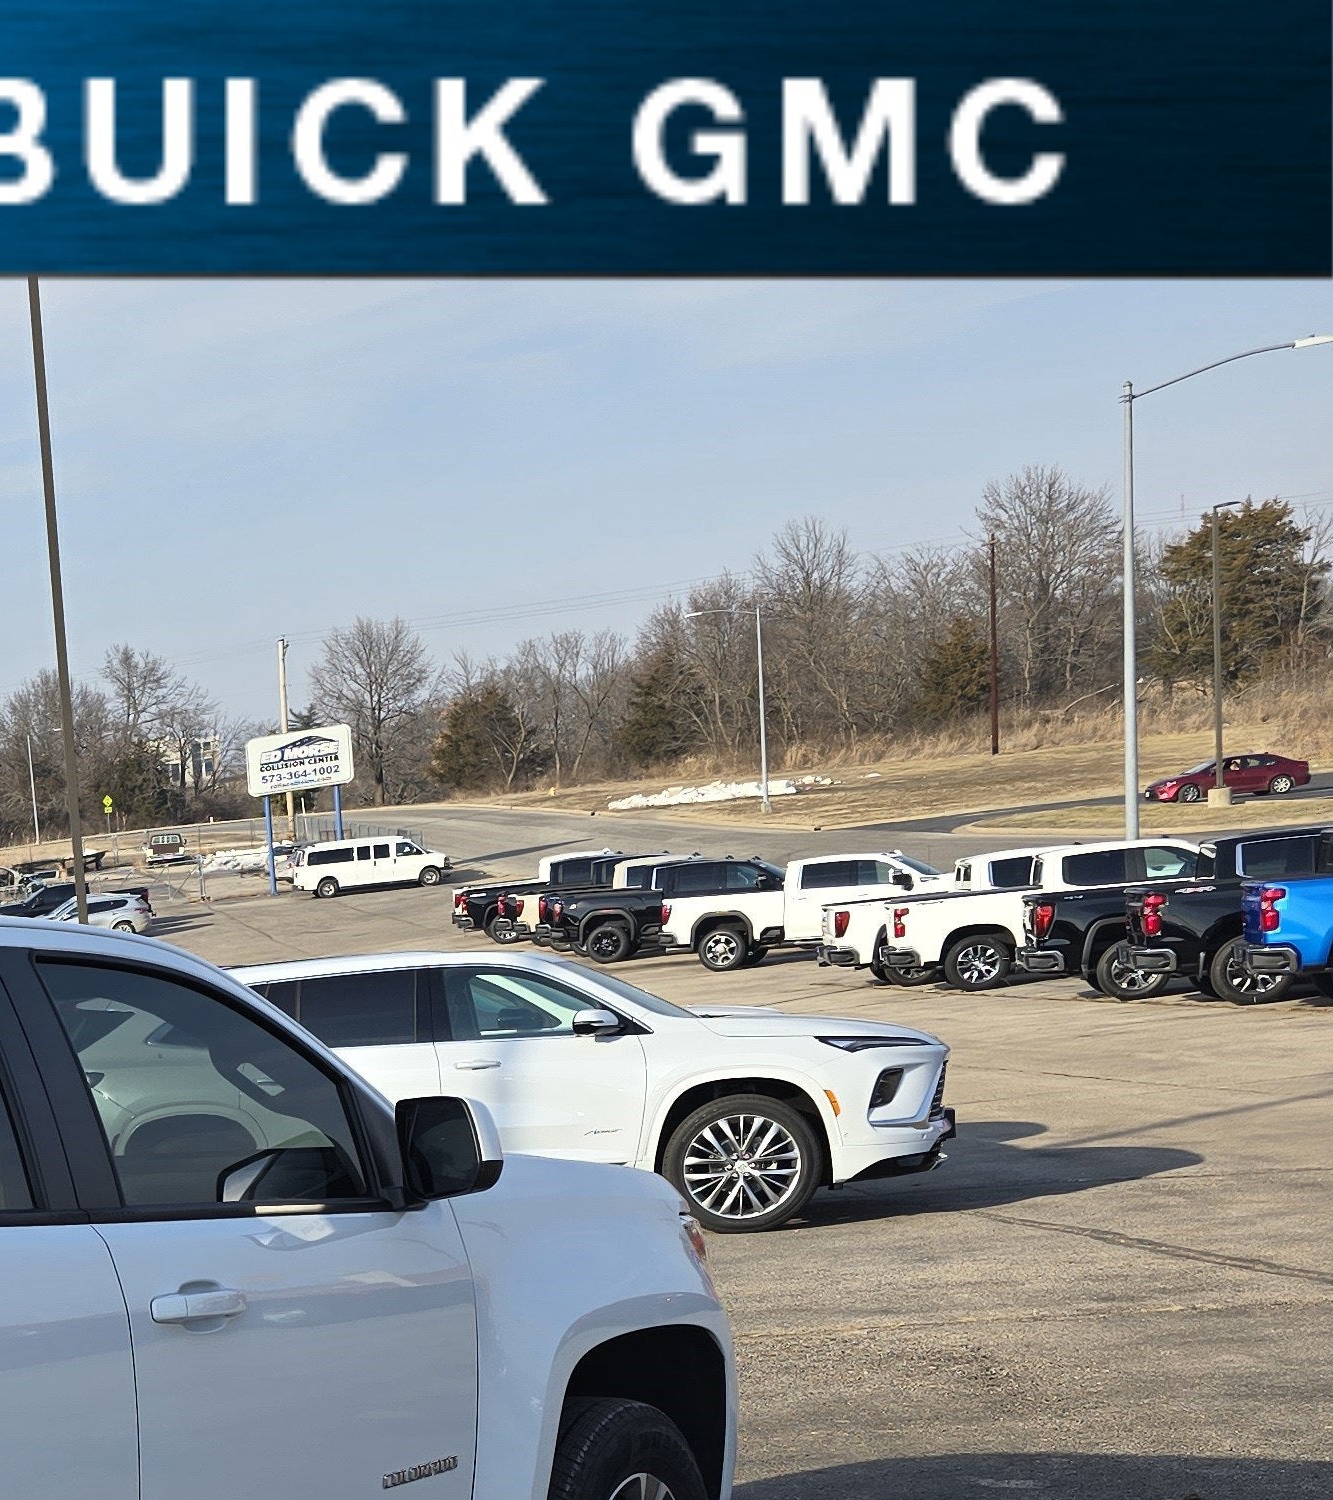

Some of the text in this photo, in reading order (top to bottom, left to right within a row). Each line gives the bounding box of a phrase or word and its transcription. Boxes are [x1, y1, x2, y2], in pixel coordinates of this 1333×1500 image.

[260, 754, 340, 773] COLLISION CENTER
[261, 750, 282, 765] ED
[261, 765, 340, 784] 573-364-1002
